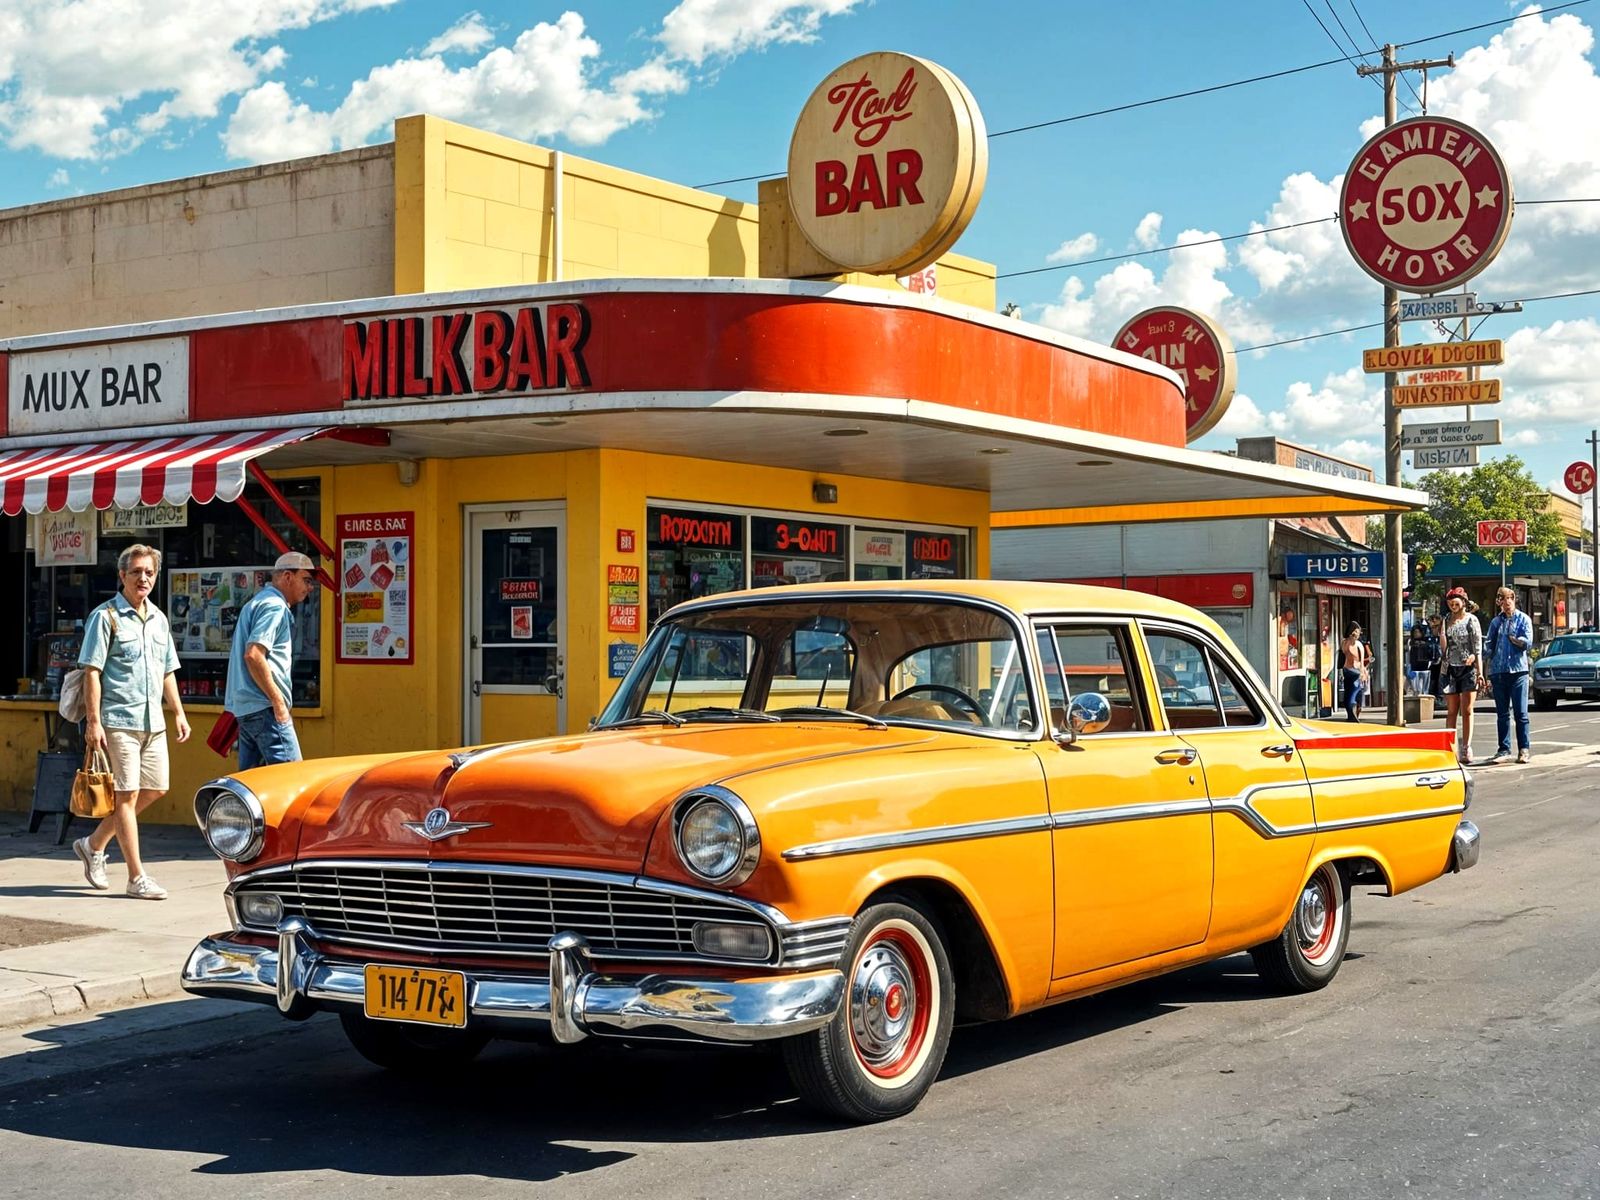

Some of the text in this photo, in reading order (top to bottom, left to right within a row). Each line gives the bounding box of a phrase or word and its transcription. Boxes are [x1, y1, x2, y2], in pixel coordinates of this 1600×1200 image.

[815, 149, 925, 218] BAR
[1382, 181, 1464, 226] SOX
[1377, 234, 1479, 279] HORR
[23, 362, 162, 413] MUX BAR
